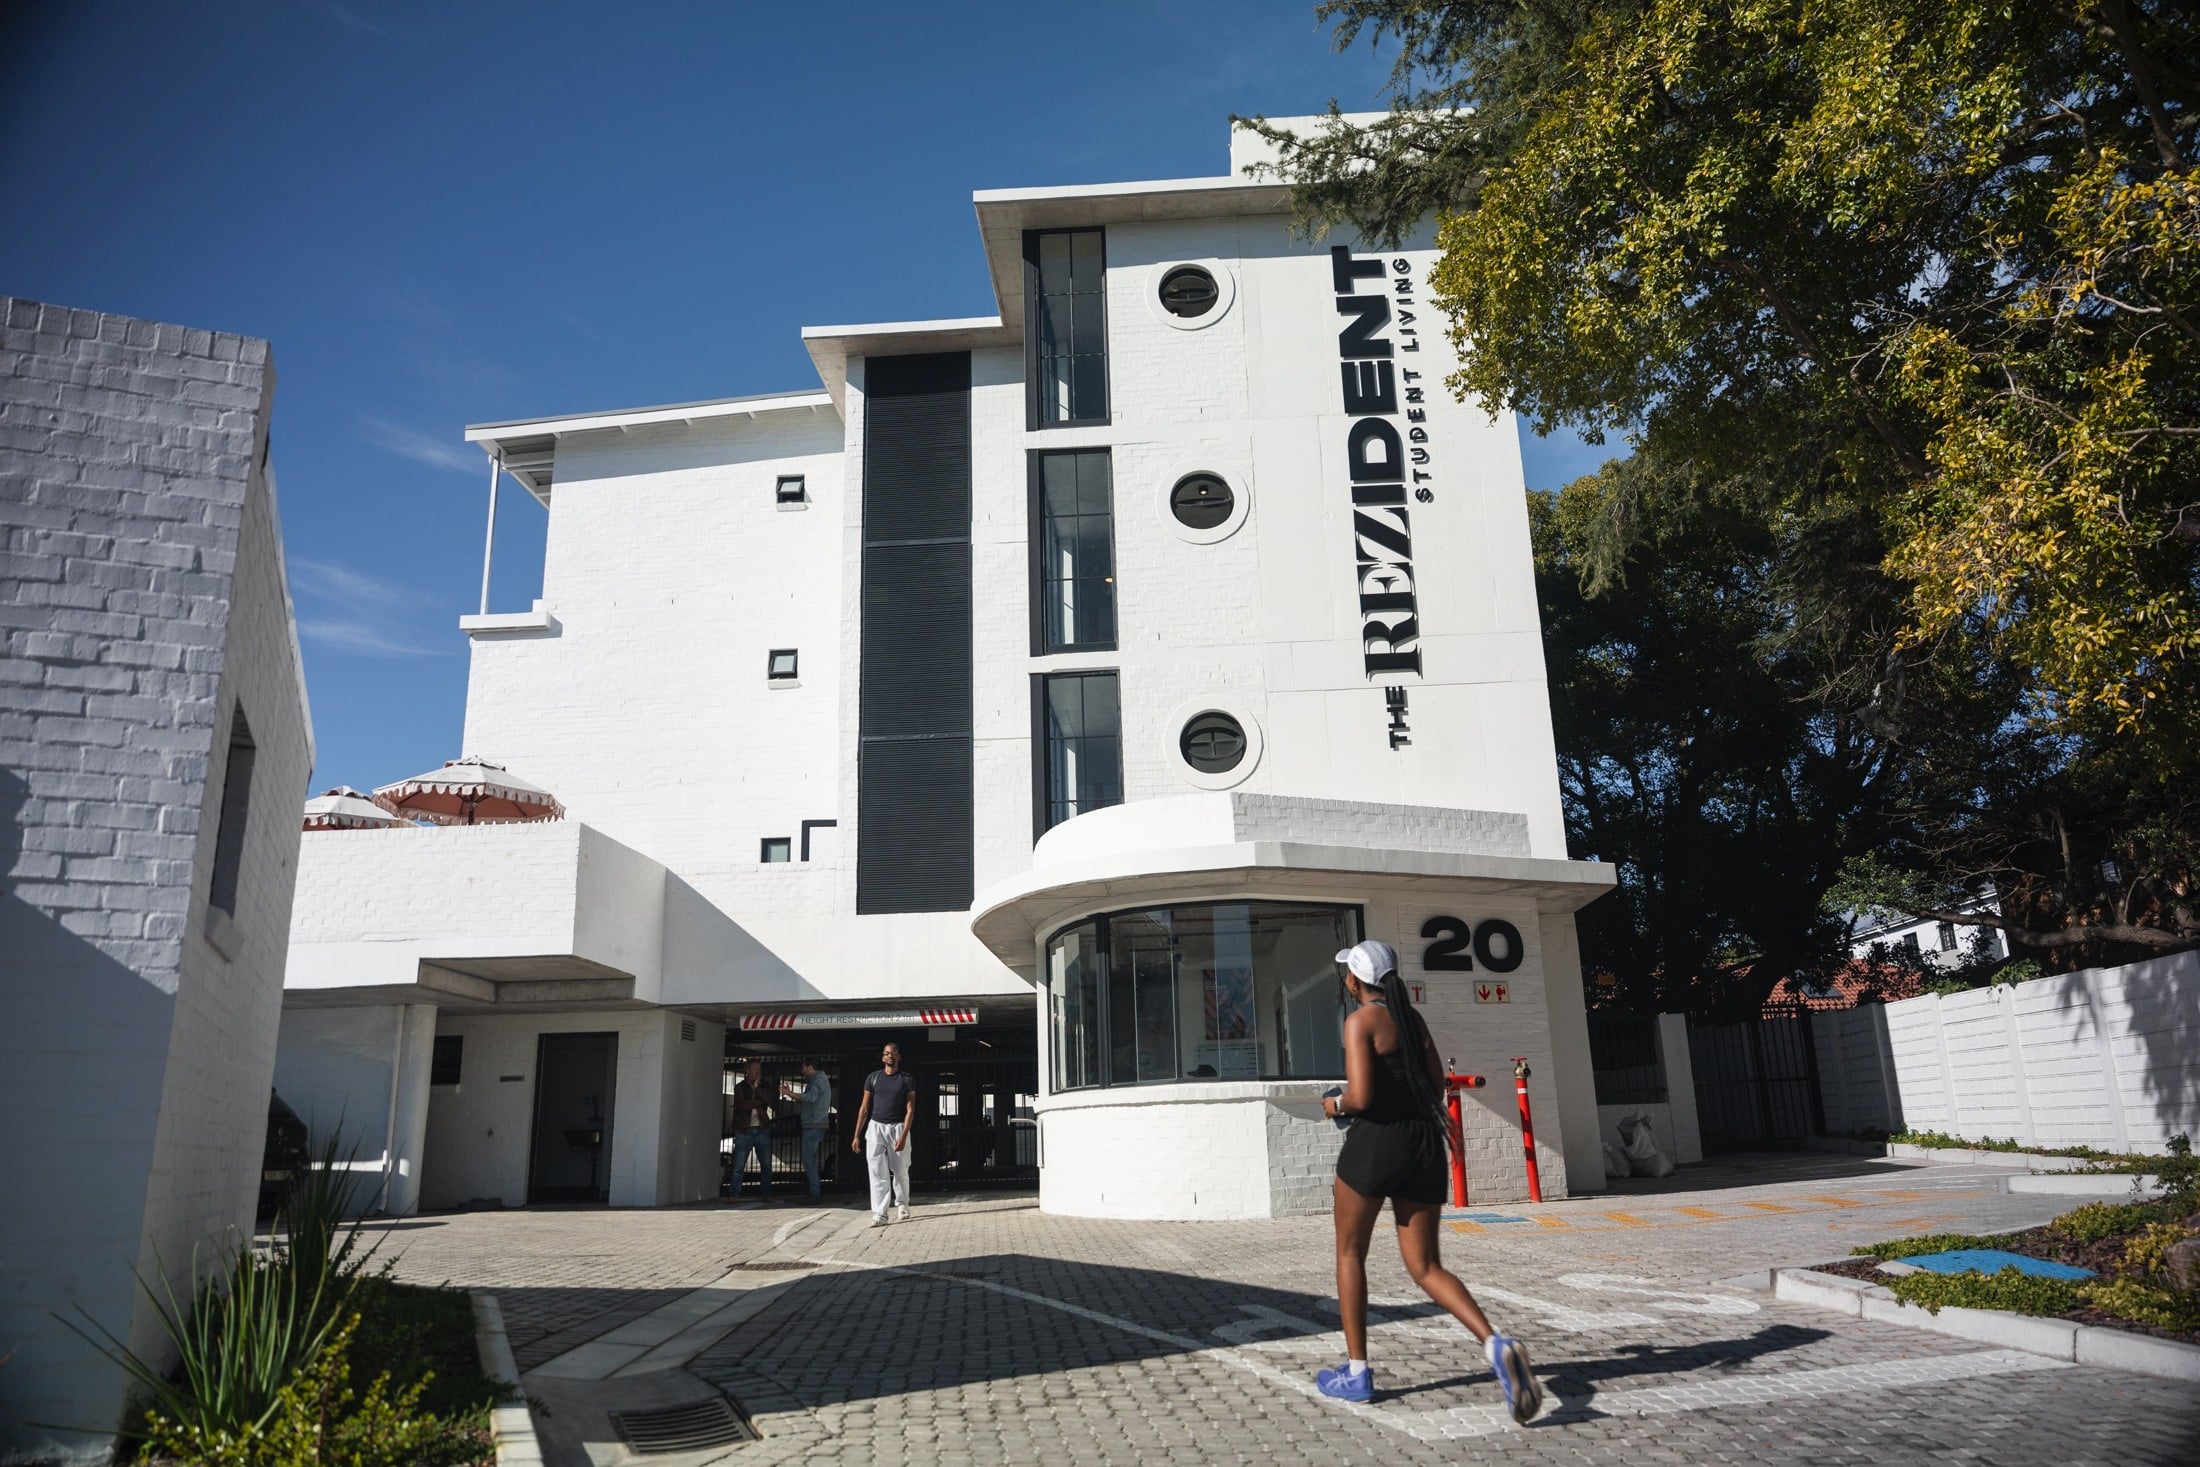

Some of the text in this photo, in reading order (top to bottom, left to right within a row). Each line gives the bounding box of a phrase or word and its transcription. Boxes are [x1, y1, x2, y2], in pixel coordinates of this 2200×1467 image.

[1393, 258, 1432, 503] STUDENT LIVING
[1331, 246, 1421, 748] THE REZIDENT
[801, 1015, 834, 1025] HEIGHT
[836, 1014, 894, 1024] RESTRICTION
[1420, 915, 1524, 973] 20
